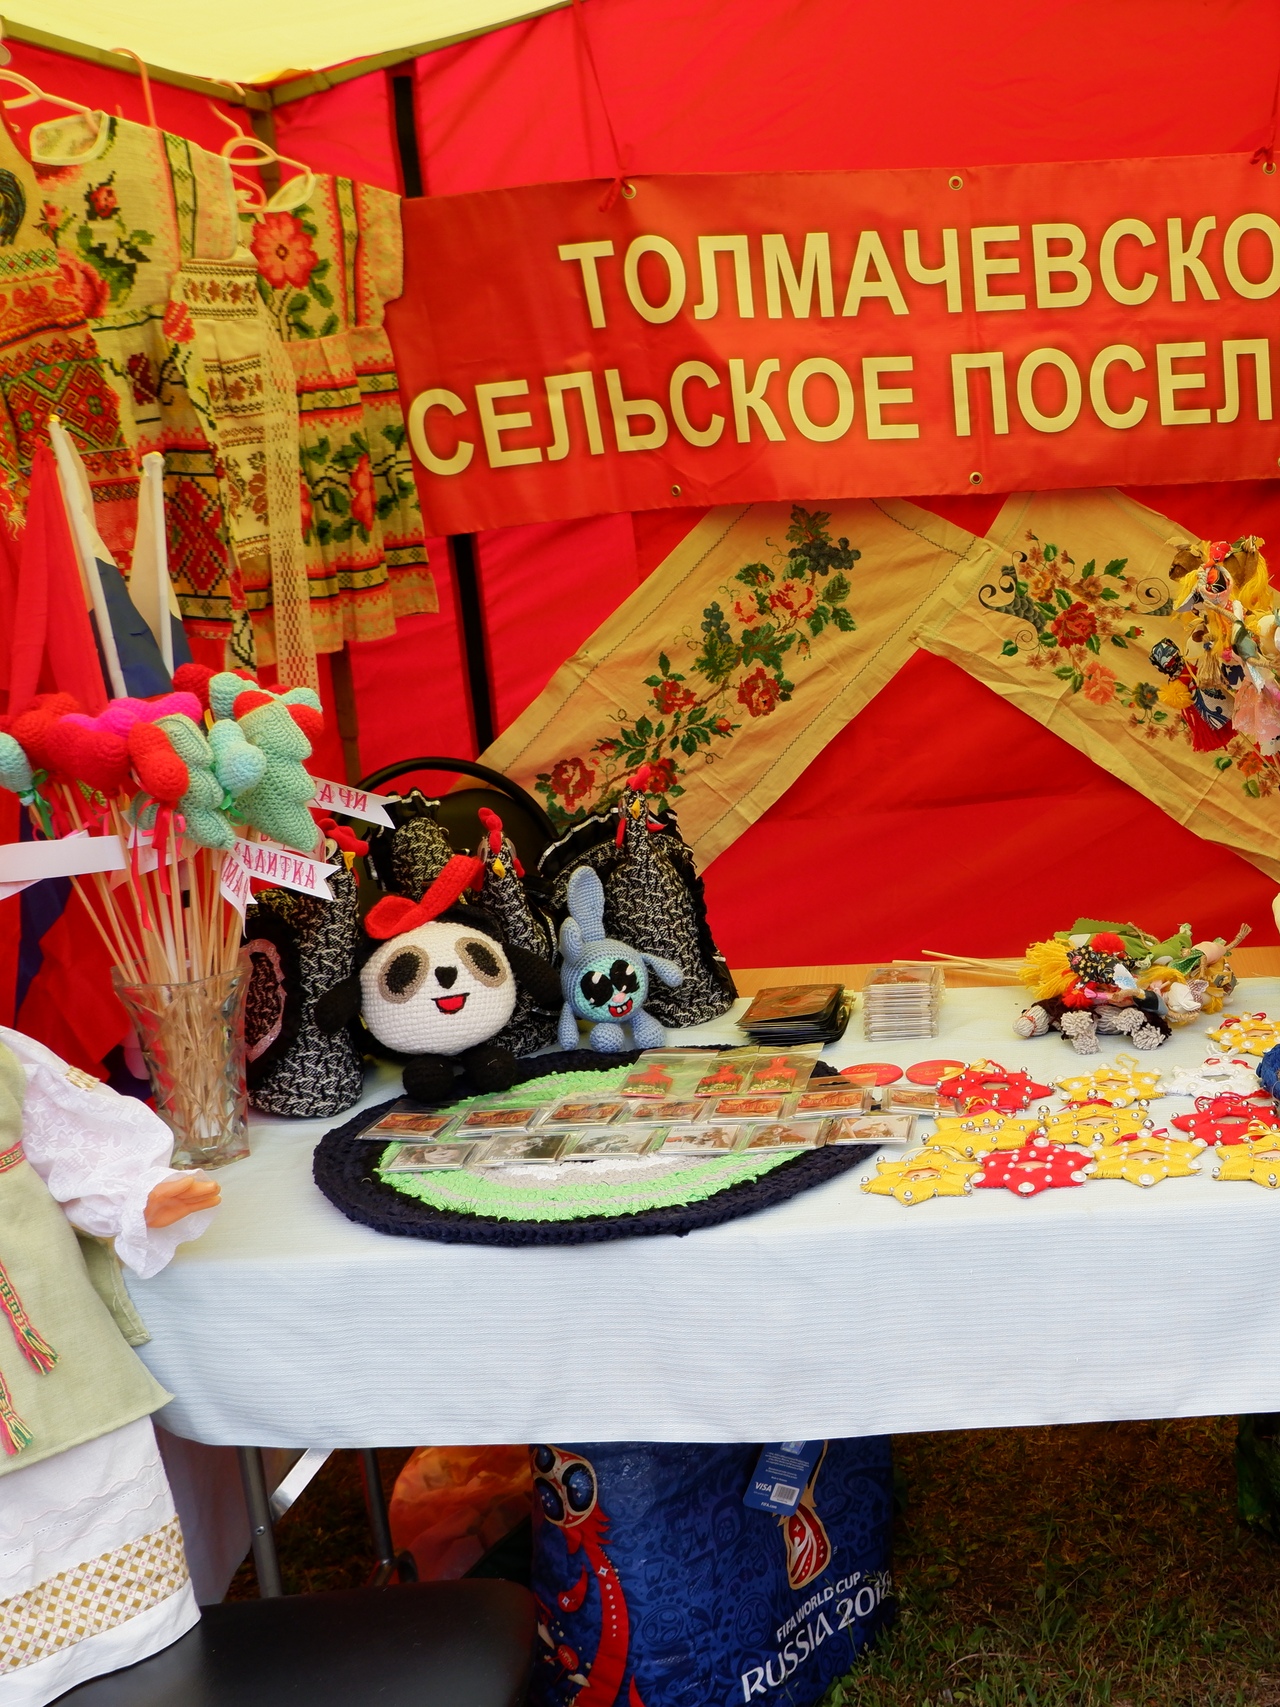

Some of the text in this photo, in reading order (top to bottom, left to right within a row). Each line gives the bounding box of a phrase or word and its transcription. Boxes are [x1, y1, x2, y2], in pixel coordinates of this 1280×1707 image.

[409, 355, 920, 475] СЕЛЬСКОЕ
[315, 780, 368, 812] АЧИ
[755, 1482, 772, 1492] VISA
[776, 1571, 861, 1643] FIFA WORLD CUP
[741, 1612, 834, 1703] RUSSIA
